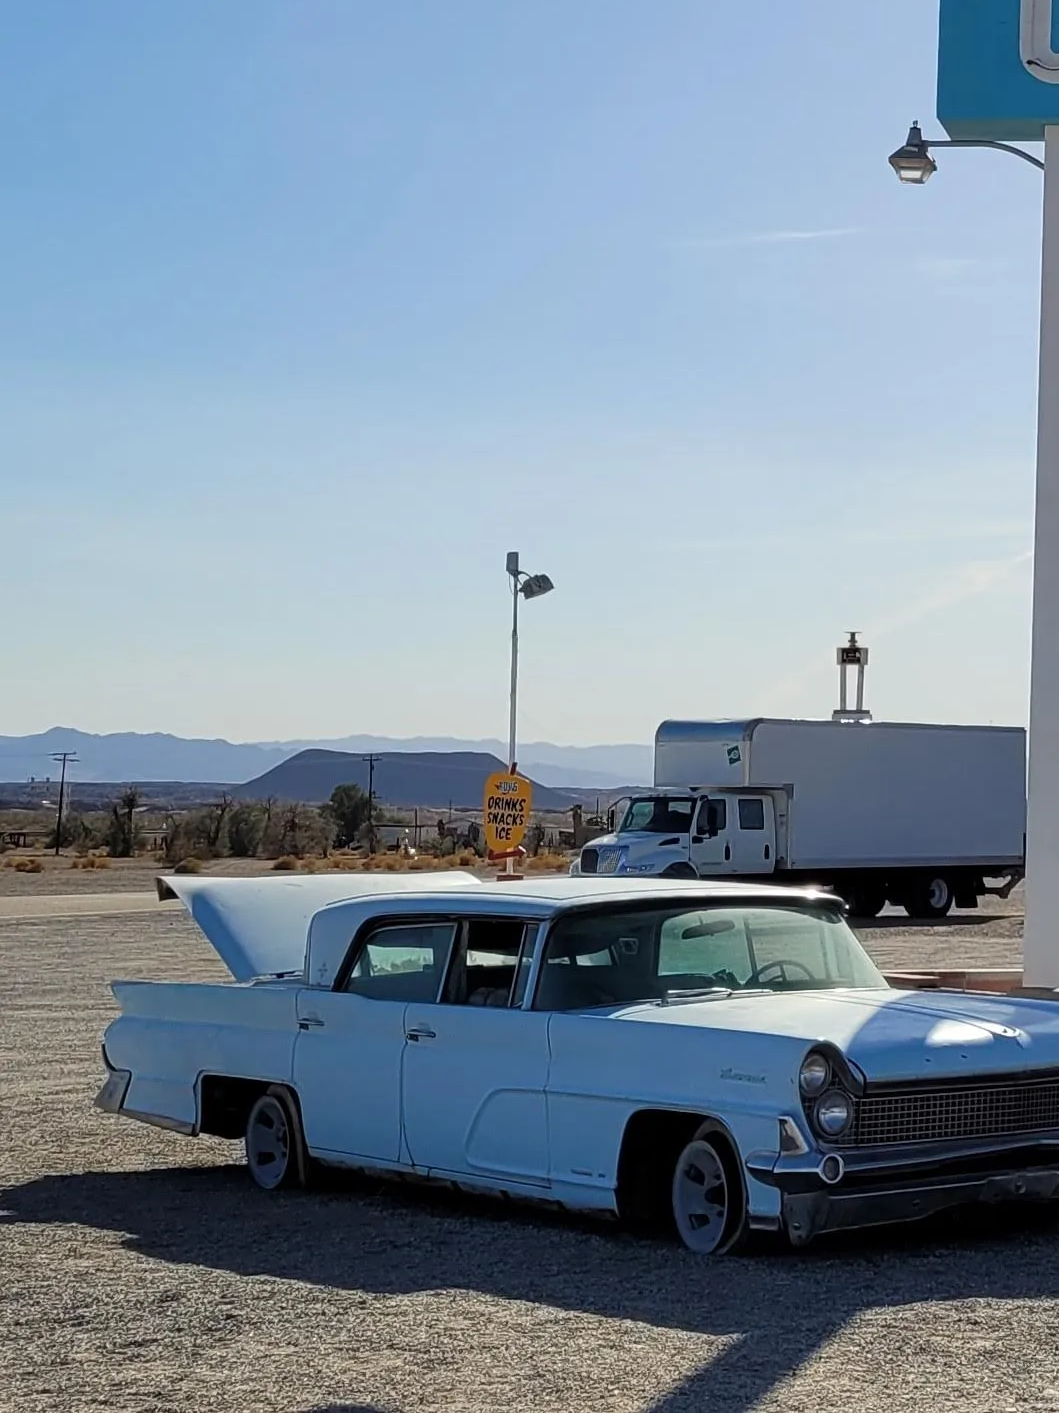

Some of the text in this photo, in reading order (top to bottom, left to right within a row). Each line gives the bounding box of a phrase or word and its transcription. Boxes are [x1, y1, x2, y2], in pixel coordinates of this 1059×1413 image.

[487, 795, 527, 812] DRINKS
[486, 811, 525, 827] SNACKS
[495, 827, 513, 841] ICE
